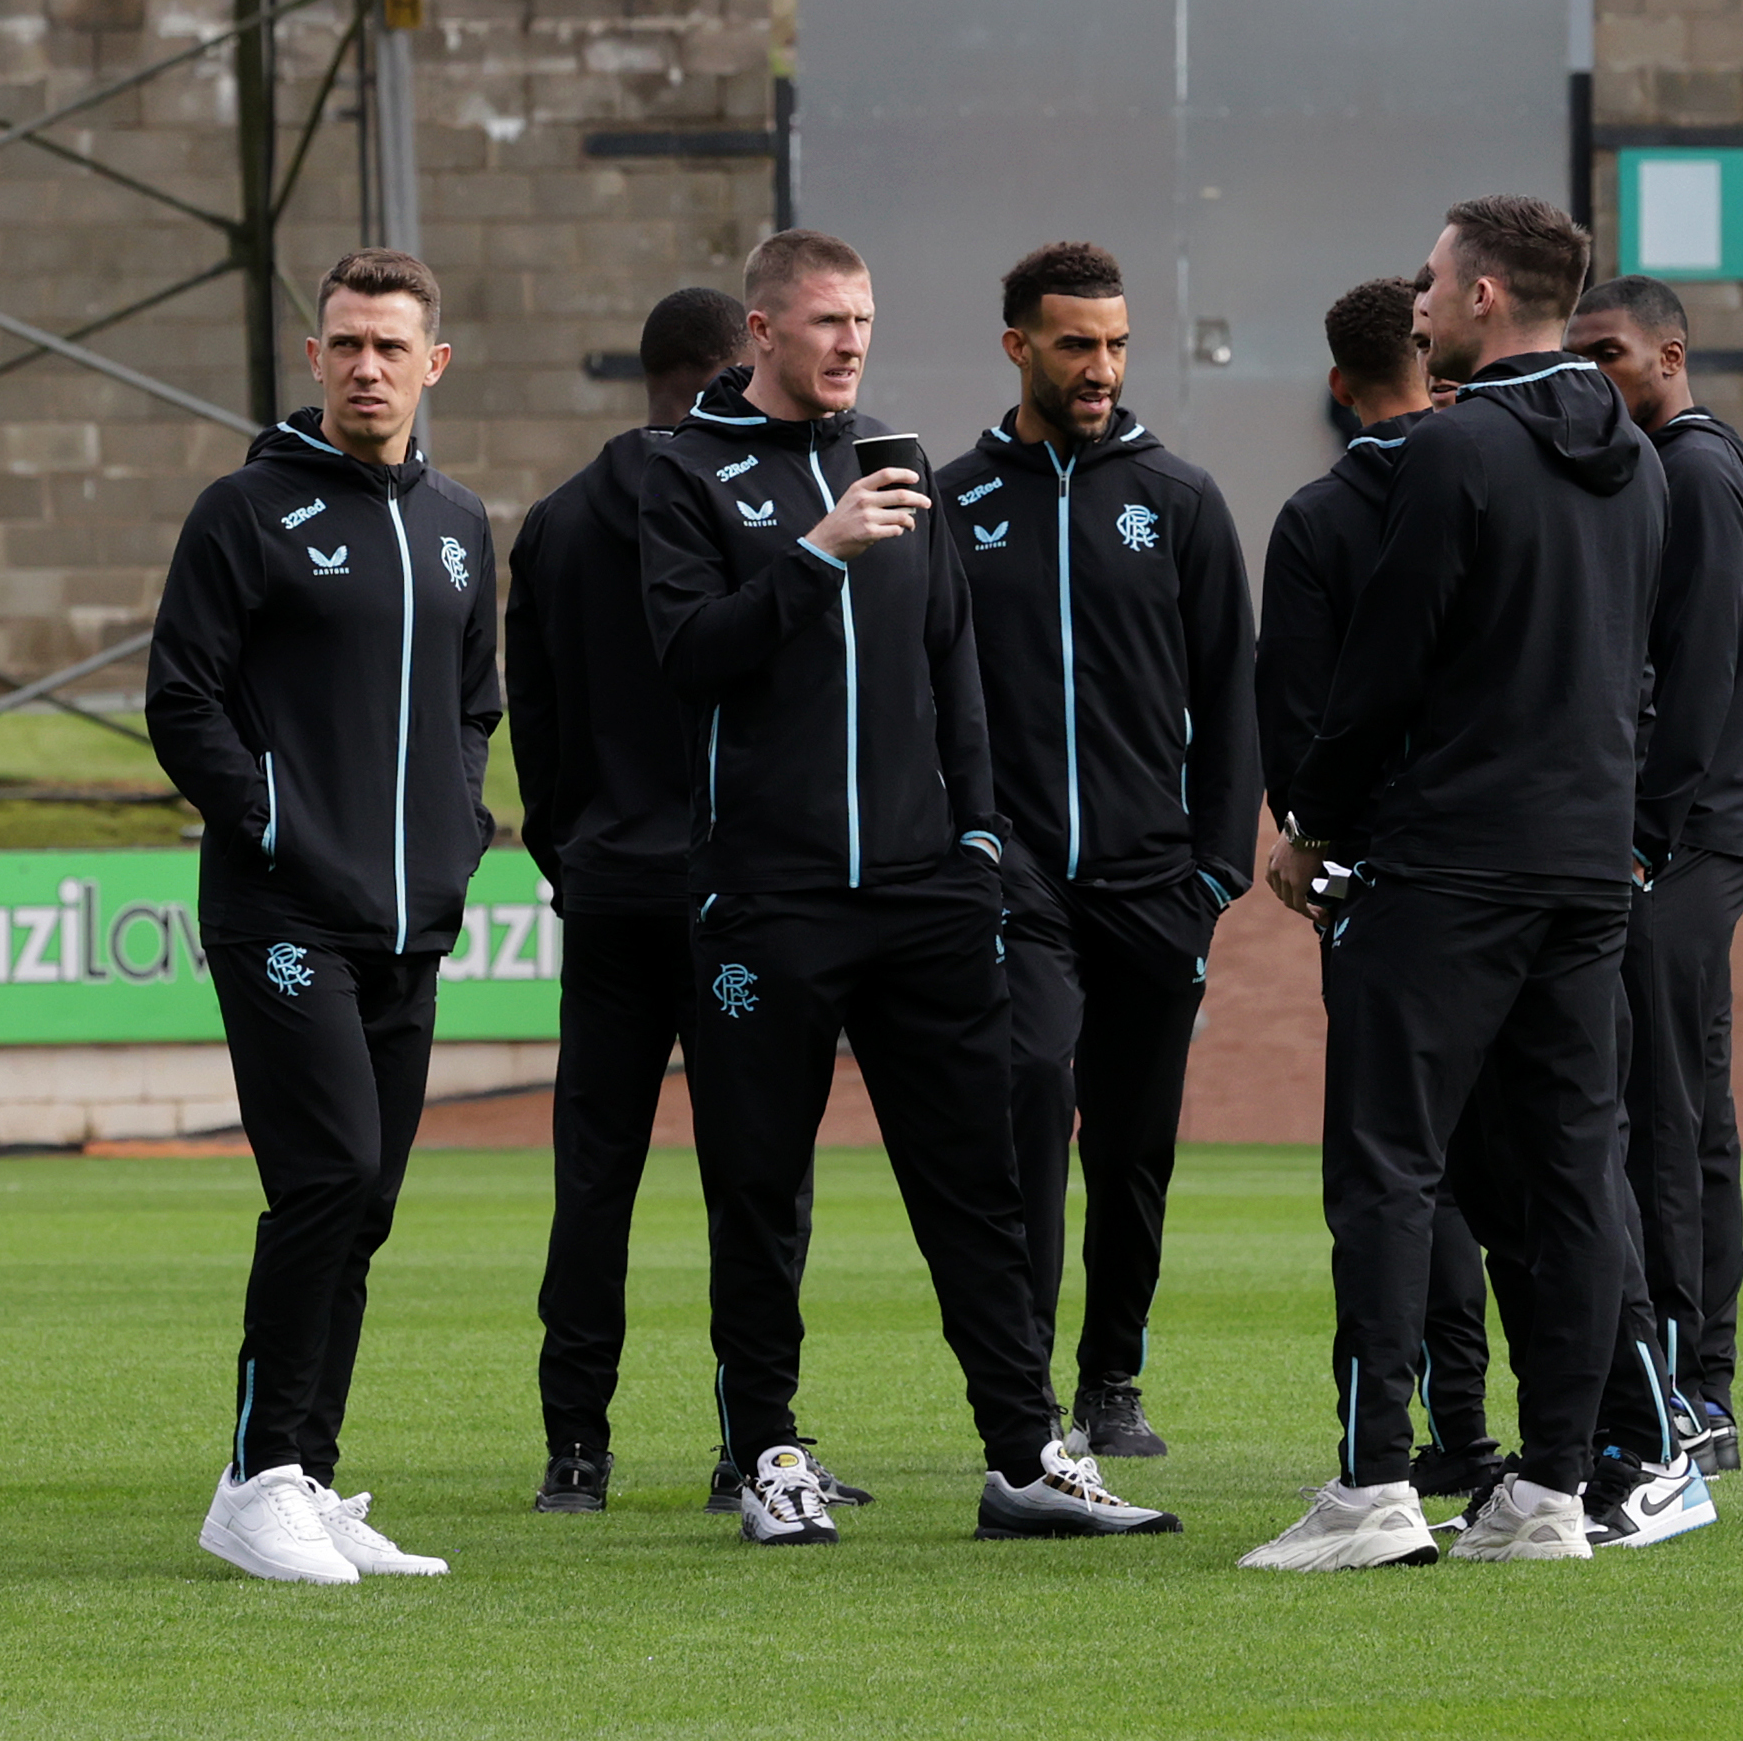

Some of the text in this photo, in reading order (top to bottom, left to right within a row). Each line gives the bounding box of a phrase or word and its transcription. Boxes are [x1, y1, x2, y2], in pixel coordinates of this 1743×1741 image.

[716, 454, 759, 482] 32Red
[957, 476, 1004, 506] 32Red
[281, 497, 327, 530] 32Red
